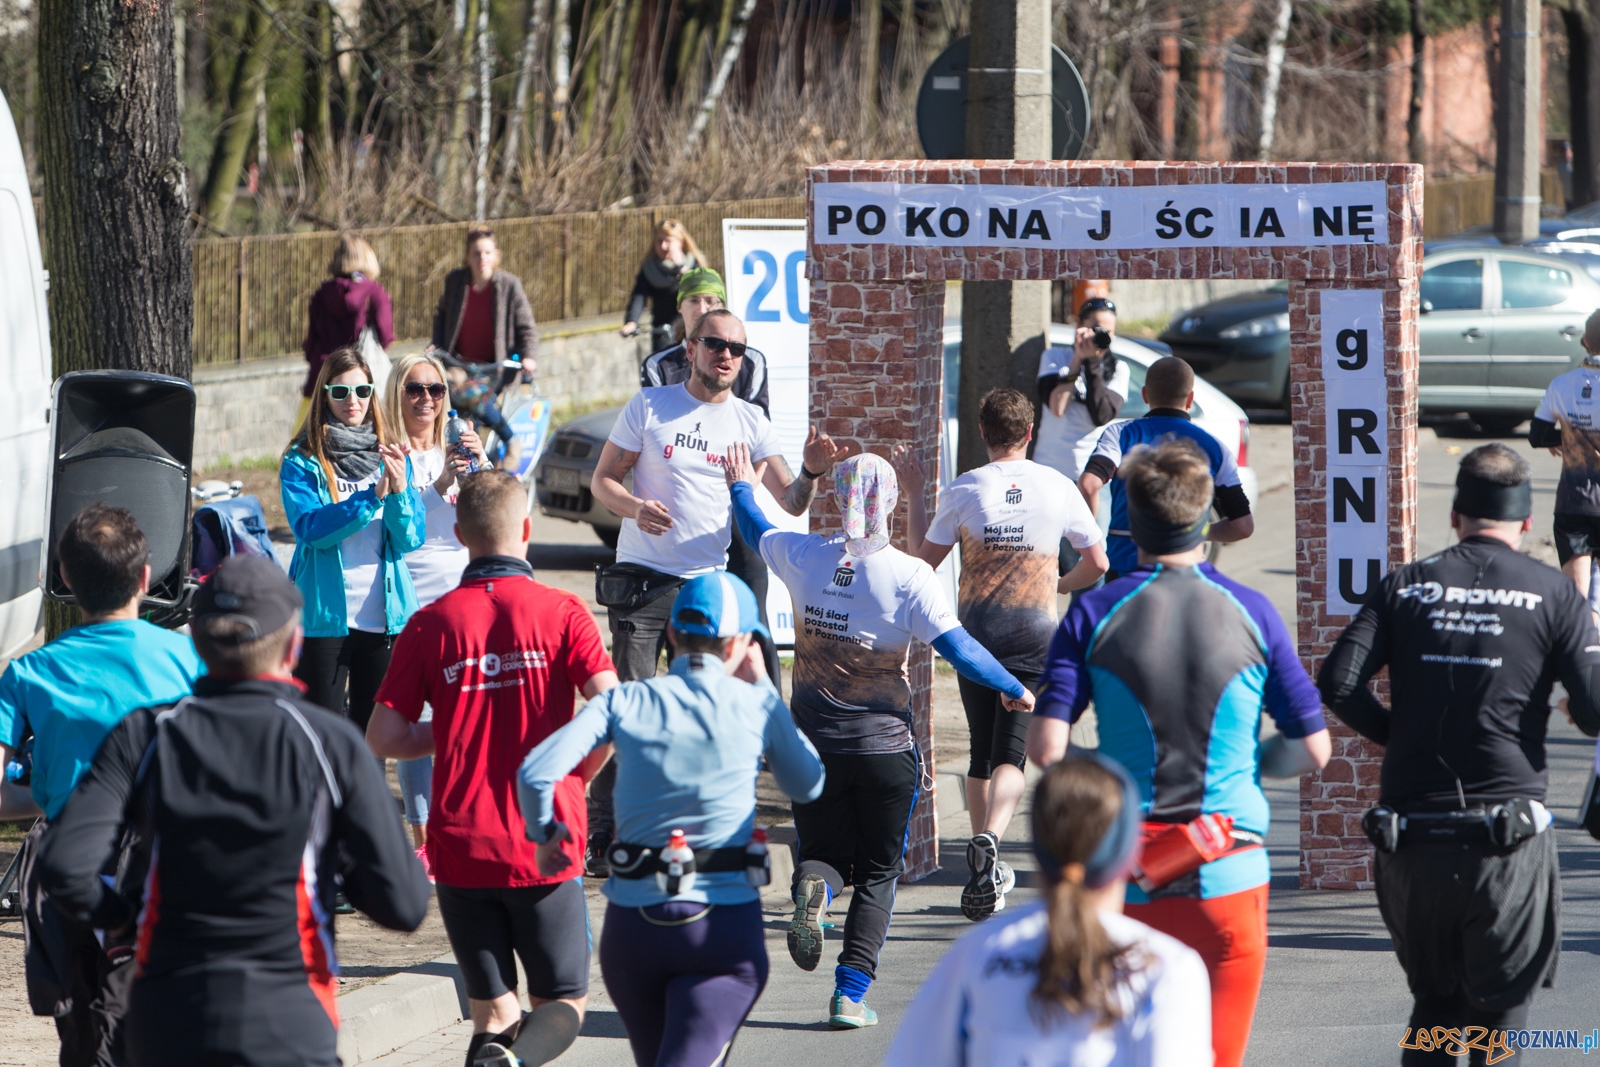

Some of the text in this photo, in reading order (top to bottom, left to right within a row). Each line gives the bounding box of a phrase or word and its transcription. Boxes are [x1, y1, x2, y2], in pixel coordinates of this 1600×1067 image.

[984, 525, 1024, 536] Mój ślad
[984, 534, 1024, 544] pozostał
[992, 543, 1035, 552] Poznaniu
[822, 589, 855, 599] Bank Polski
[1444, 586, 1543, 610] ROWIT
[804, 604, 849, 622] Mój ślad
[804, 617, 849, 633] pozostał
[805, 627, 862, 645] w Poznaniu
